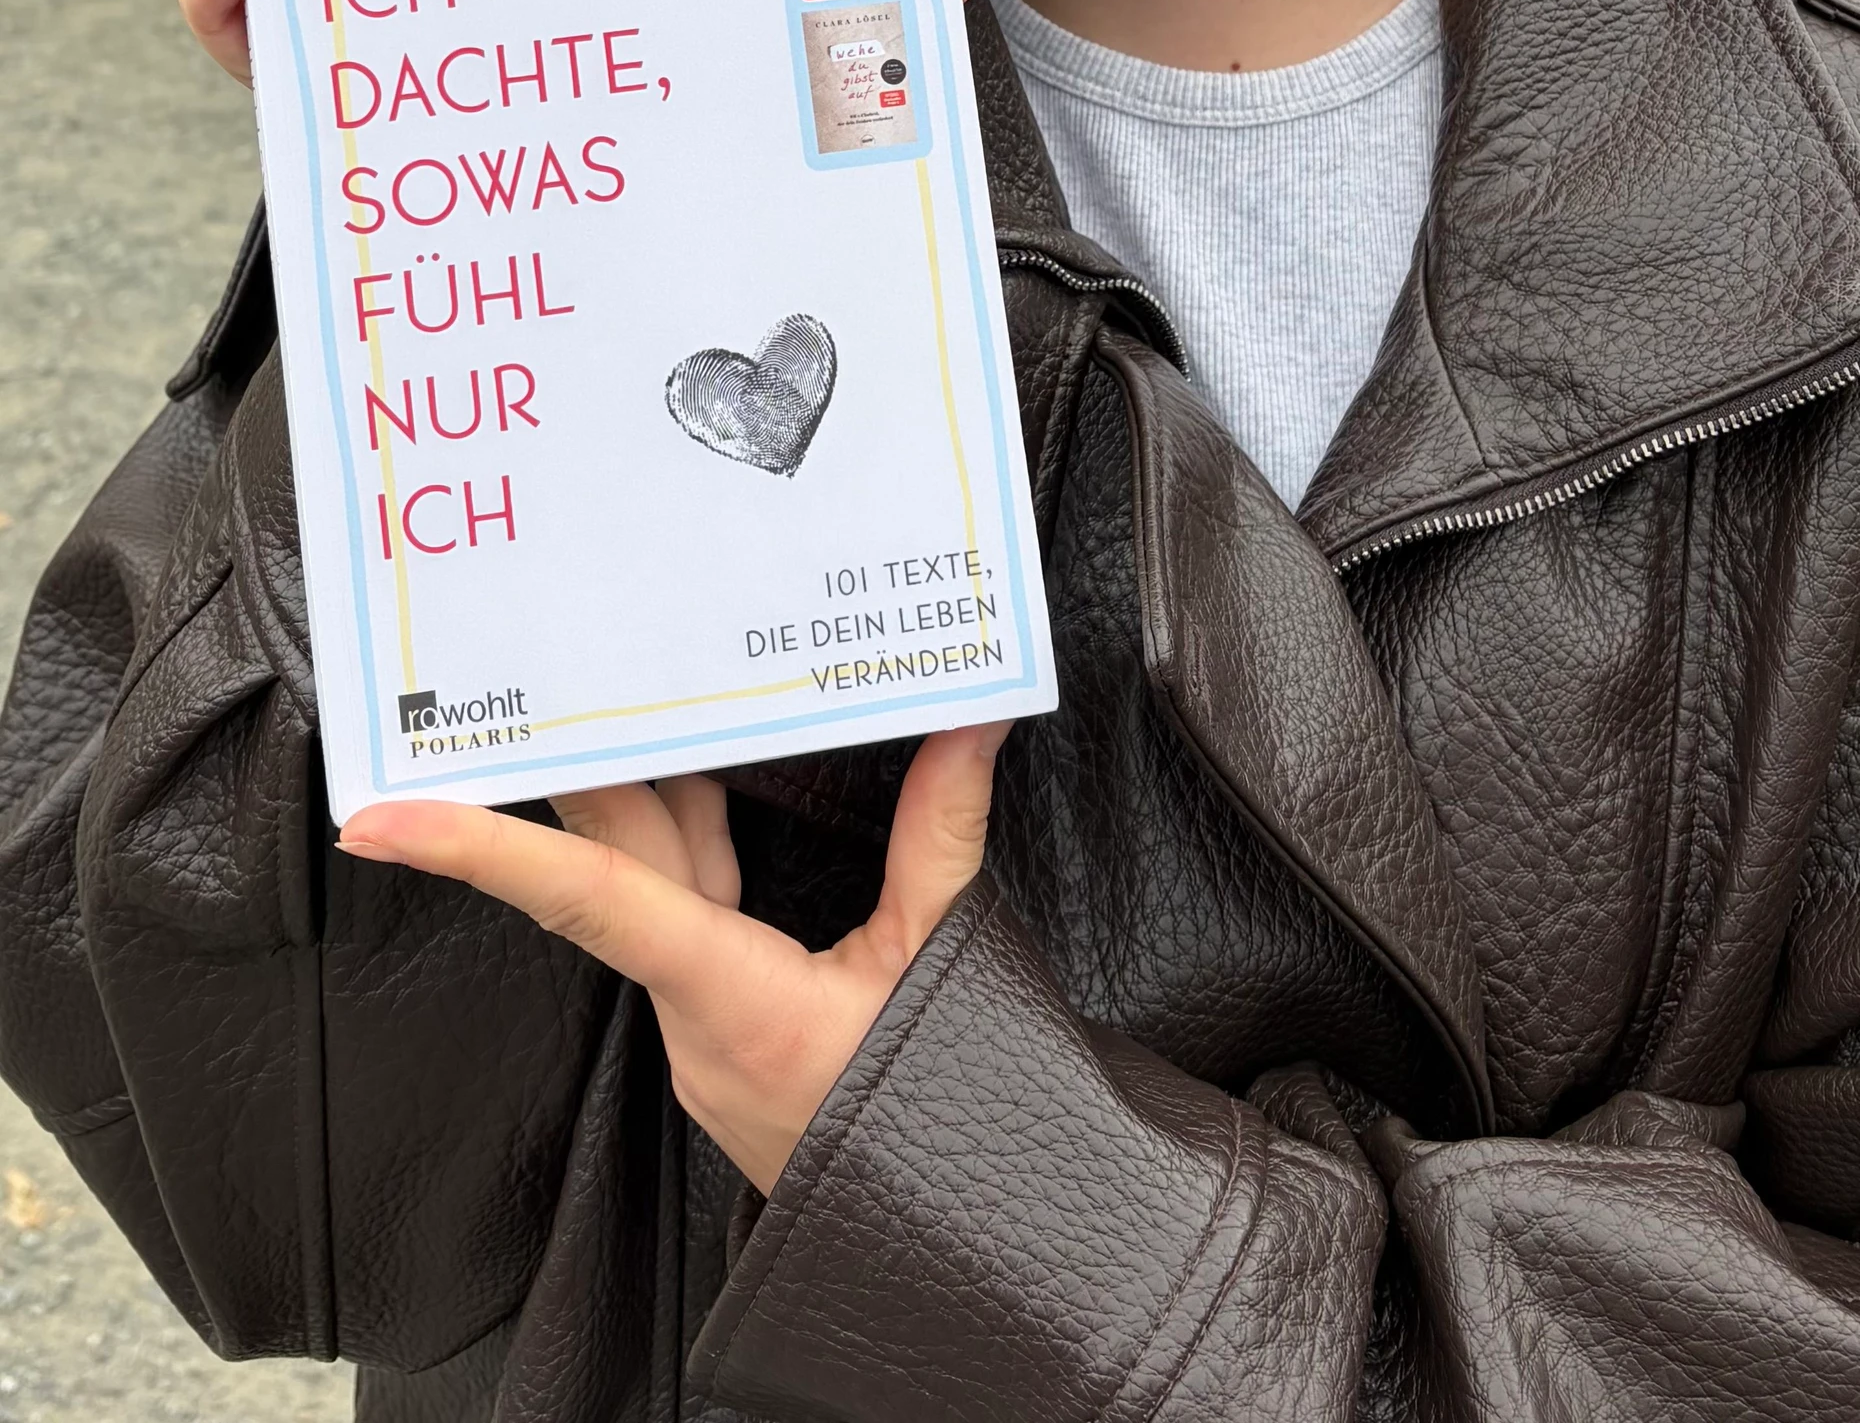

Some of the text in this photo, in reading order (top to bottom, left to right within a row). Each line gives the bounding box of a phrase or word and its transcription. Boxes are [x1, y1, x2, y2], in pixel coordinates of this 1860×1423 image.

[815, 13, 891, 29] CLARA LÖSEL
[835, 45, 877, 60] wehe
[848, 61, 870, 73] du
[329, 27, 672, 131] DACHTE,
[840, 71, 879, 91] gibst
[847, 87, 876, 100] auf
[341, 135, 626, 235] SOWAS
[353, 251, 576, 342] FÜHL
[364, 363, 541, 451] NUR
[377, 474, 517, 560] ICH
[825, 549, 992, 599] 101 TEXTE,
[745, 593, 997, 658] DIE DEIN LEBEN
[810, 638, 1003, 693] VERÄNDERN
[399, 687, 529, 734] rowohlt
[409, 723, 531, 759] POLARIS
